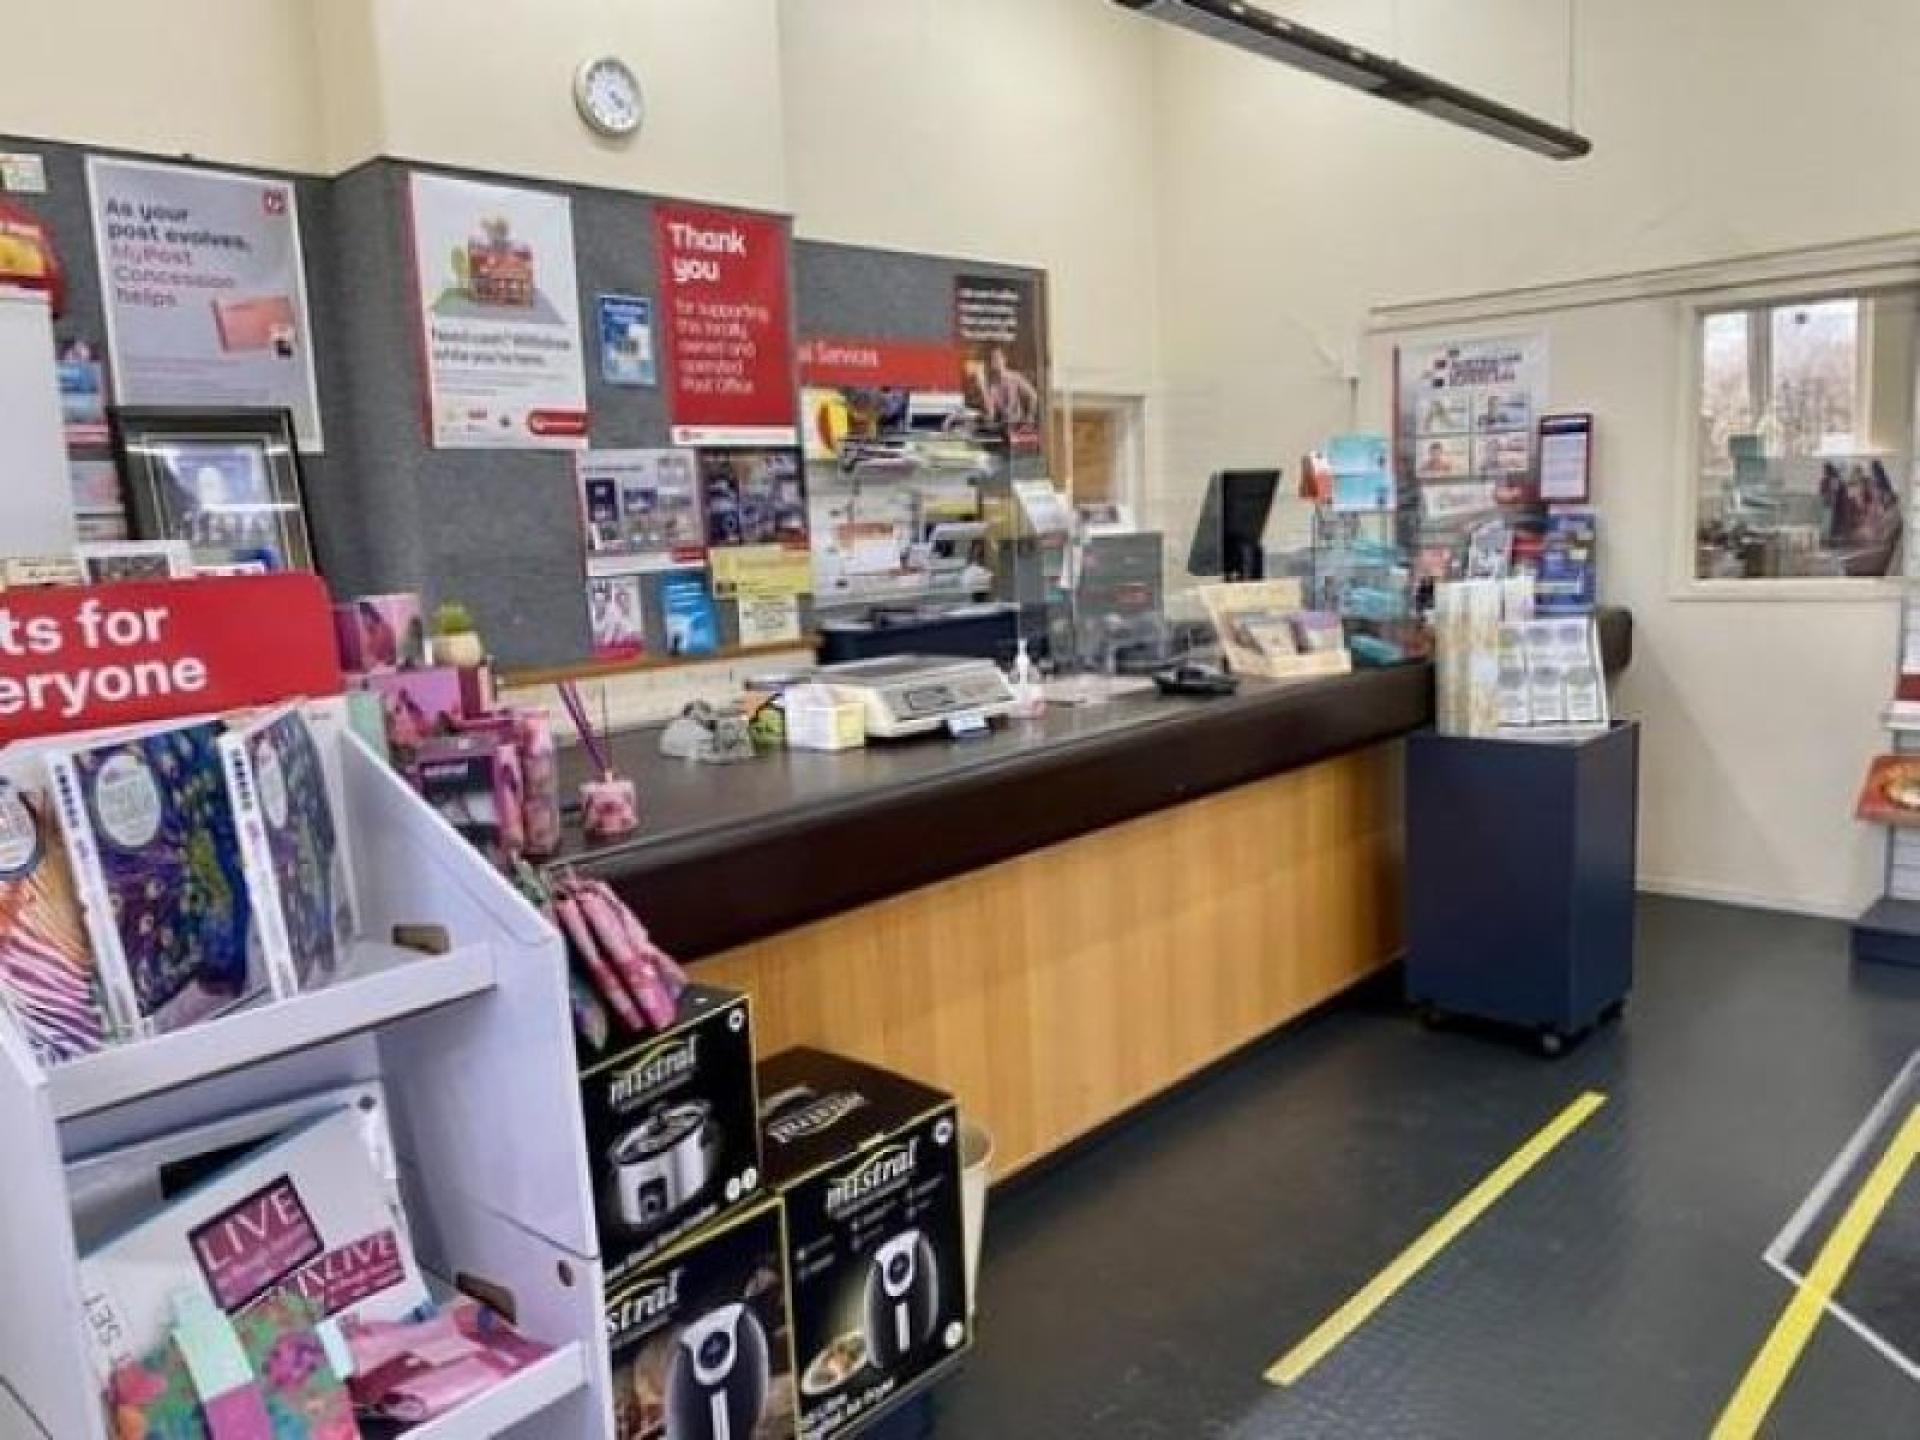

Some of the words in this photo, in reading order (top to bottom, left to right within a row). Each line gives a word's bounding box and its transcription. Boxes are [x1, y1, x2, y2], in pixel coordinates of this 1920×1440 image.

[139, 205, 188, 223] your
[107, 224, 158, 242] post
[666, 222, 748, 258] Thank
[671, 256, 721, 285] you
[75, 599, 170, 649] for
[198, 1184, 303, 1271] LIVE
